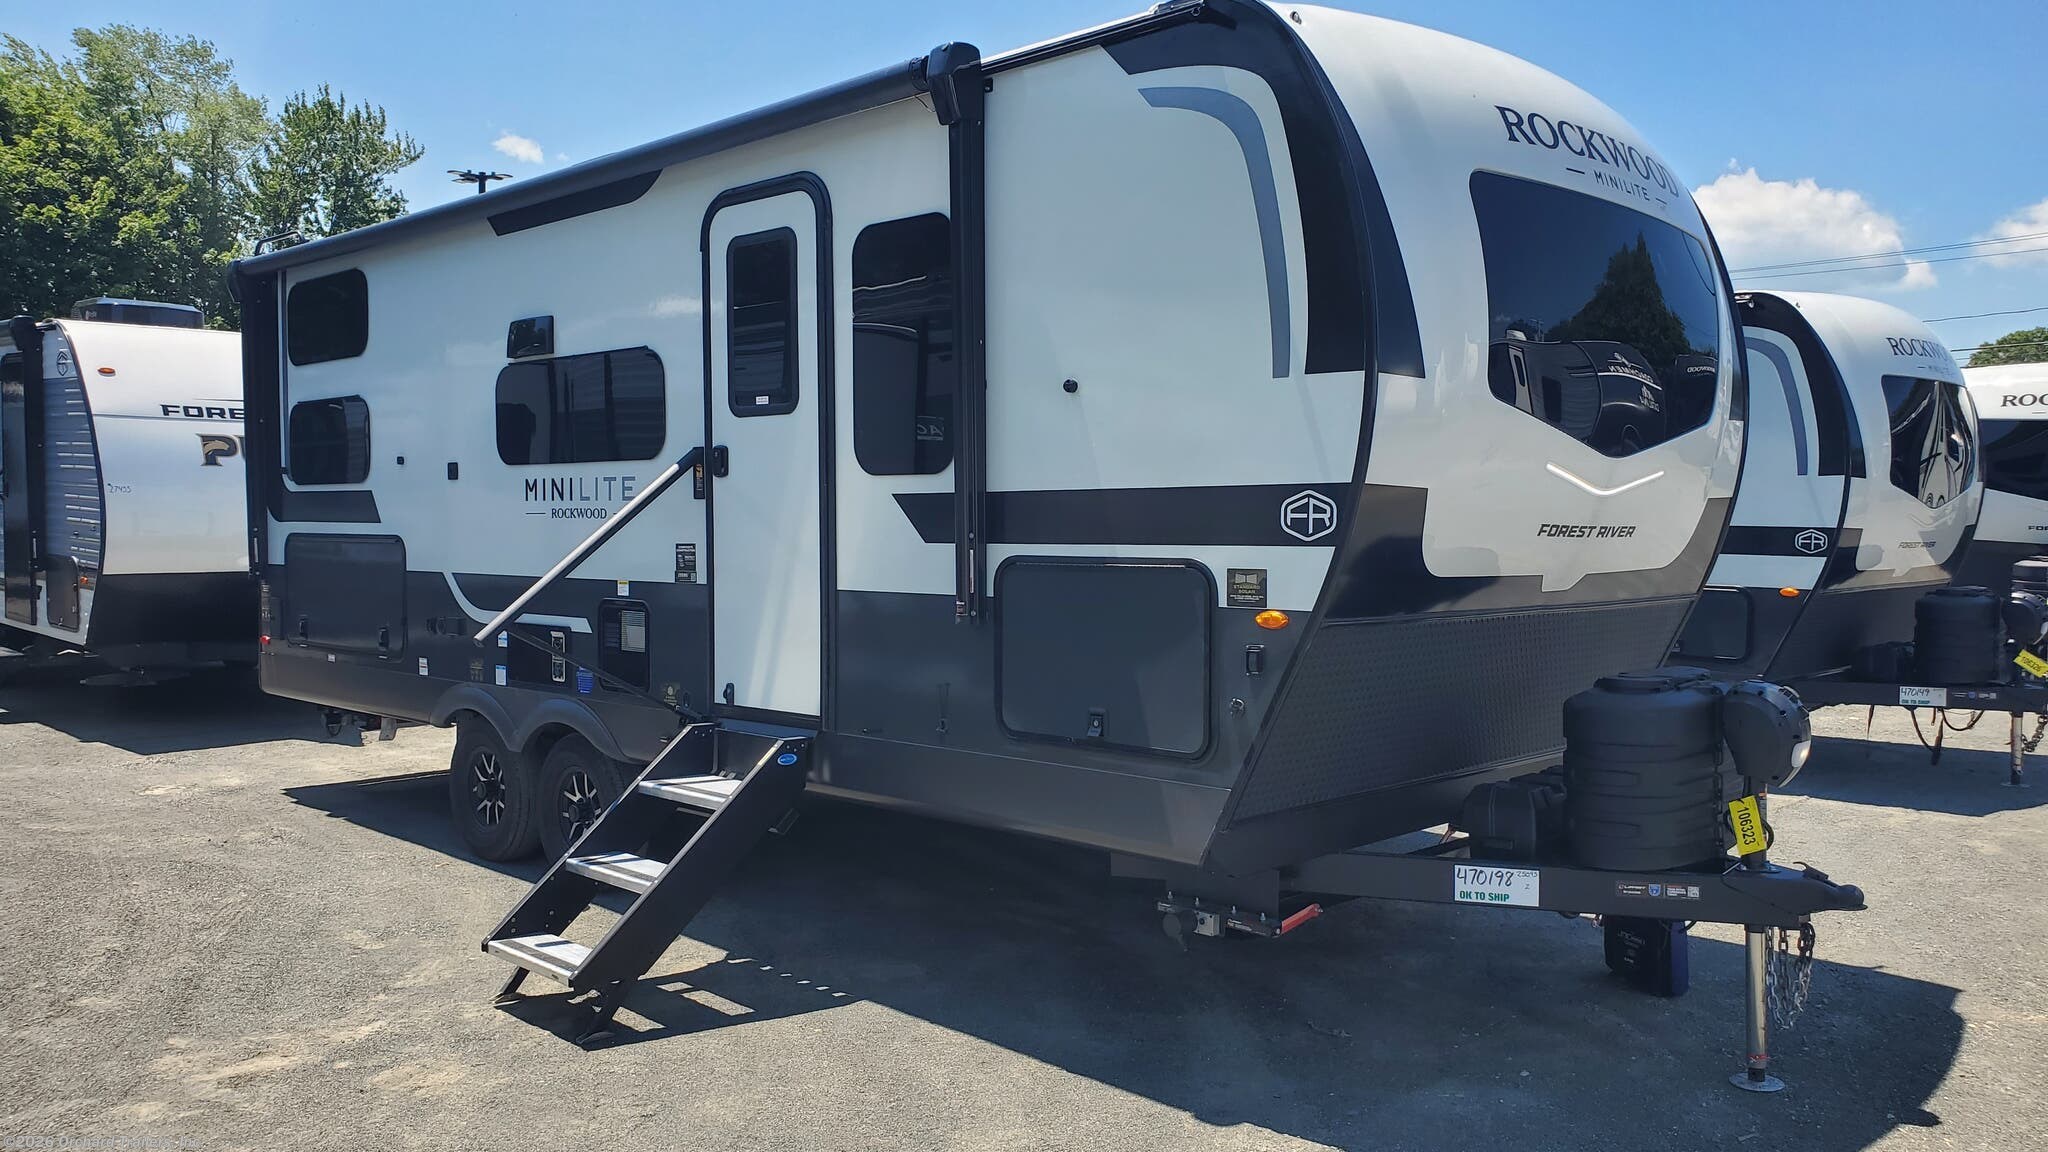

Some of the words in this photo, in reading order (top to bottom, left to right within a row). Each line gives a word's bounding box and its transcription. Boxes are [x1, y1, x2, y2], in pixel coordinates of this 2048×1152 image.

[1494, 104, 1680, 198] ROCKWOOD
[1593, 169, 1651, 201] MINILITE
[524, 475, 636, 502] MINILITE
[551, 507, 608, 520] ROCKWOOD
[1537, 523, 1597, 538] FOREST
[1595, 525, 1636, 538] RIVER
[1736, 806, 1757, 846] 106323
[1456, 866, 1515, 888] 470198
[1459, 890, 1473, 900] OK
[1474, 891, 1486, 901] TO
[1488, 892, 1510, 903] SHIP
